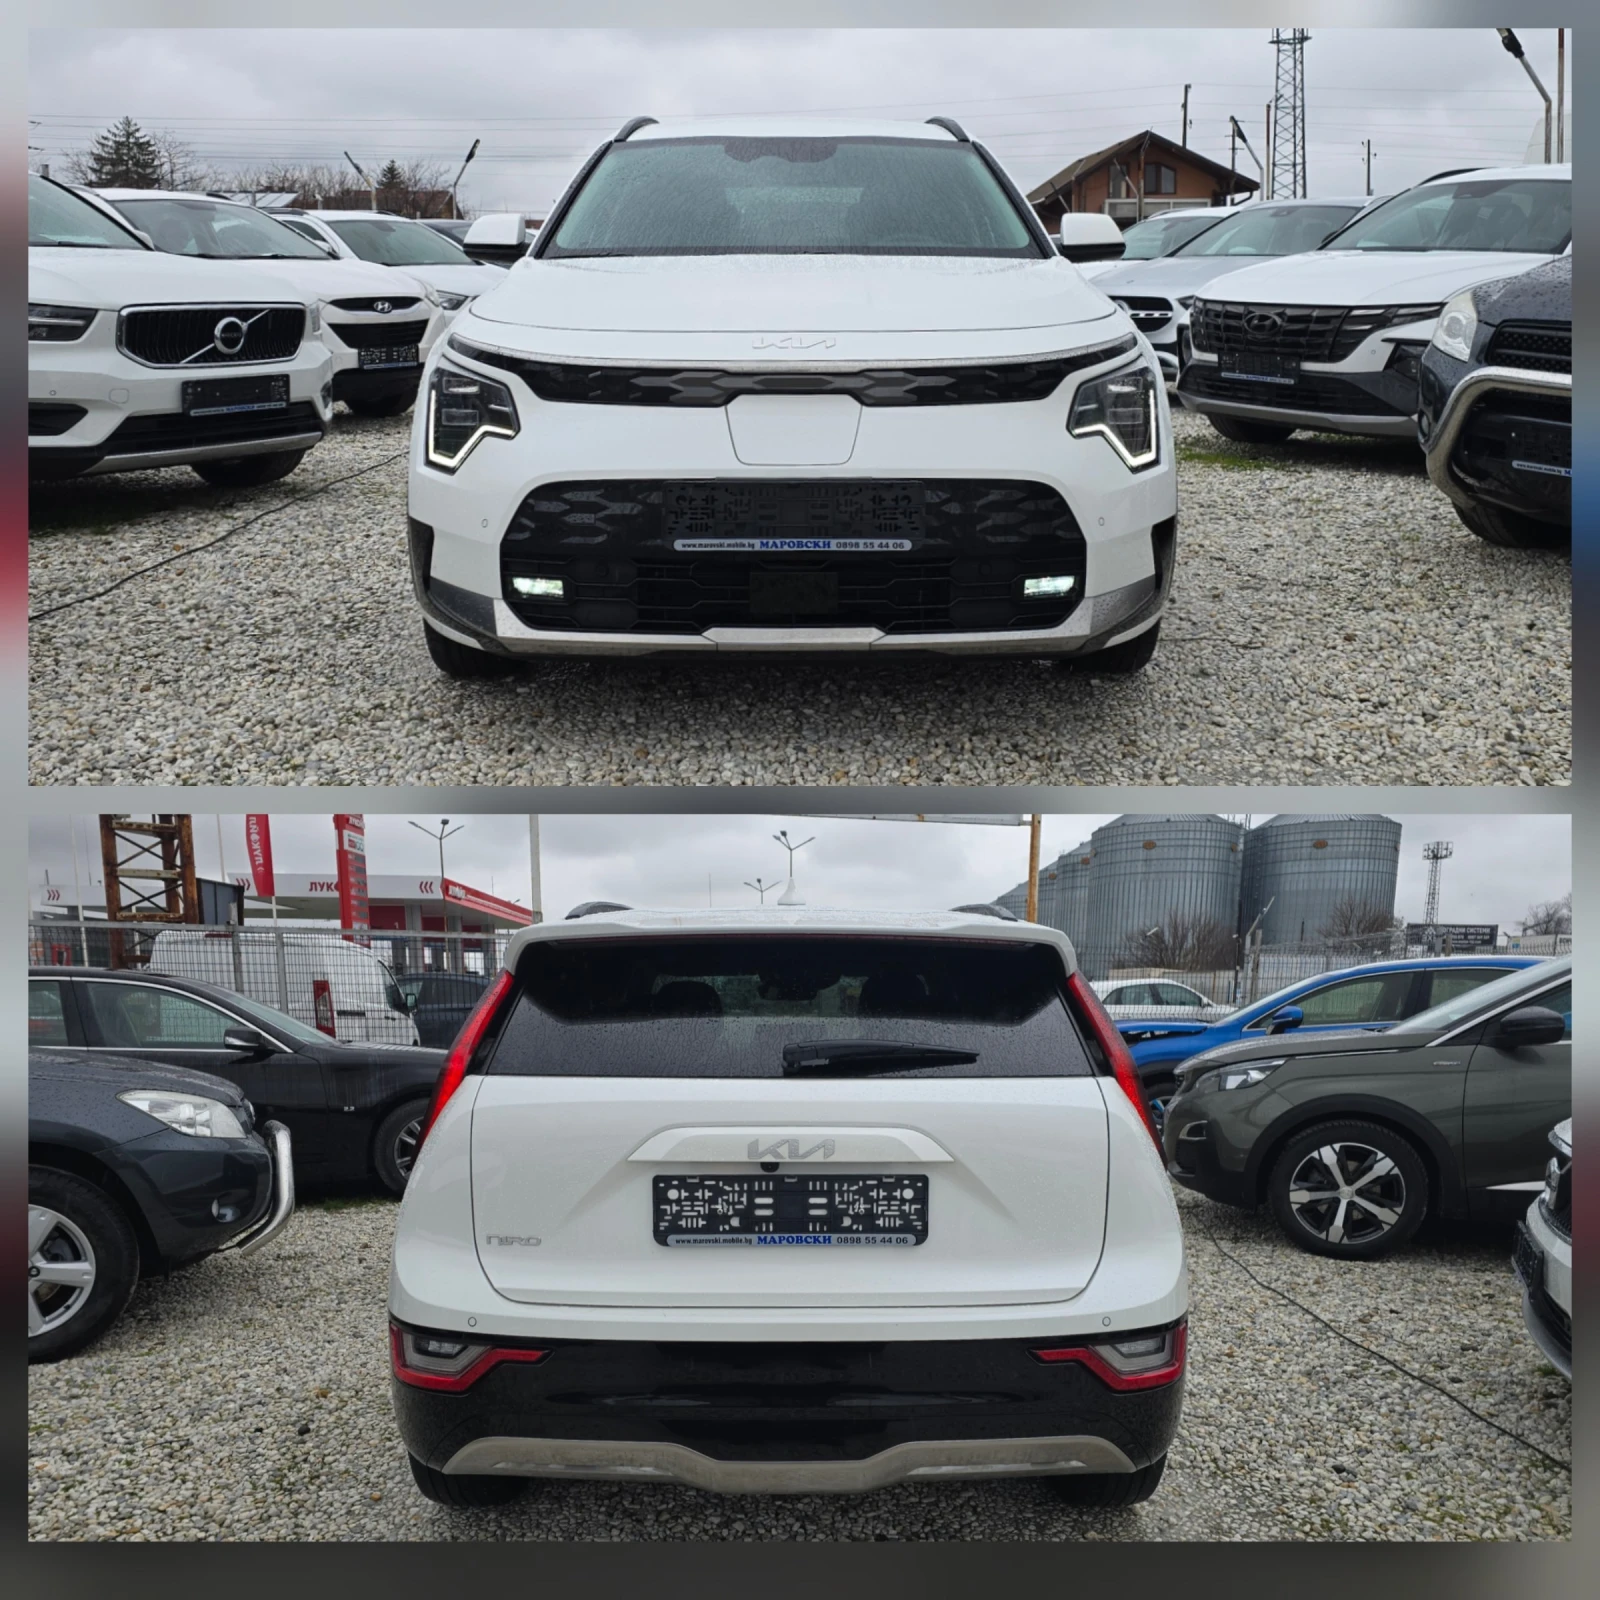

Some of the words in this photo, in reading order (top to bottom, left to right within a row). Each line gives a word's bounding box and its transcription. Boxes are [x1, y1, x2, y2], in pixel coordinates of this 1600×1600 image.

[752, 335, 836, 350] KIA
[760, 540, 831, 549] МАРОВСКИ
[835, 541, 860, 549] 0898
[863, 541, 875, 549] 55
[877, 541, 890, 549] 44
[892, 541, 905, 549] 06
[747, 1138, 836, 1160] KIA
[675, 1237, 753, 1246] www.marovski.mobile.bg
[757, 1235, 832, 1245] МАРОВСКИ
[836, 1236, 861, 1245] 0898
[865, 1236, 877, 1245] 55
[880, 1236, 893, 1245] 44
[896, 1236, 909, 1245] 06
